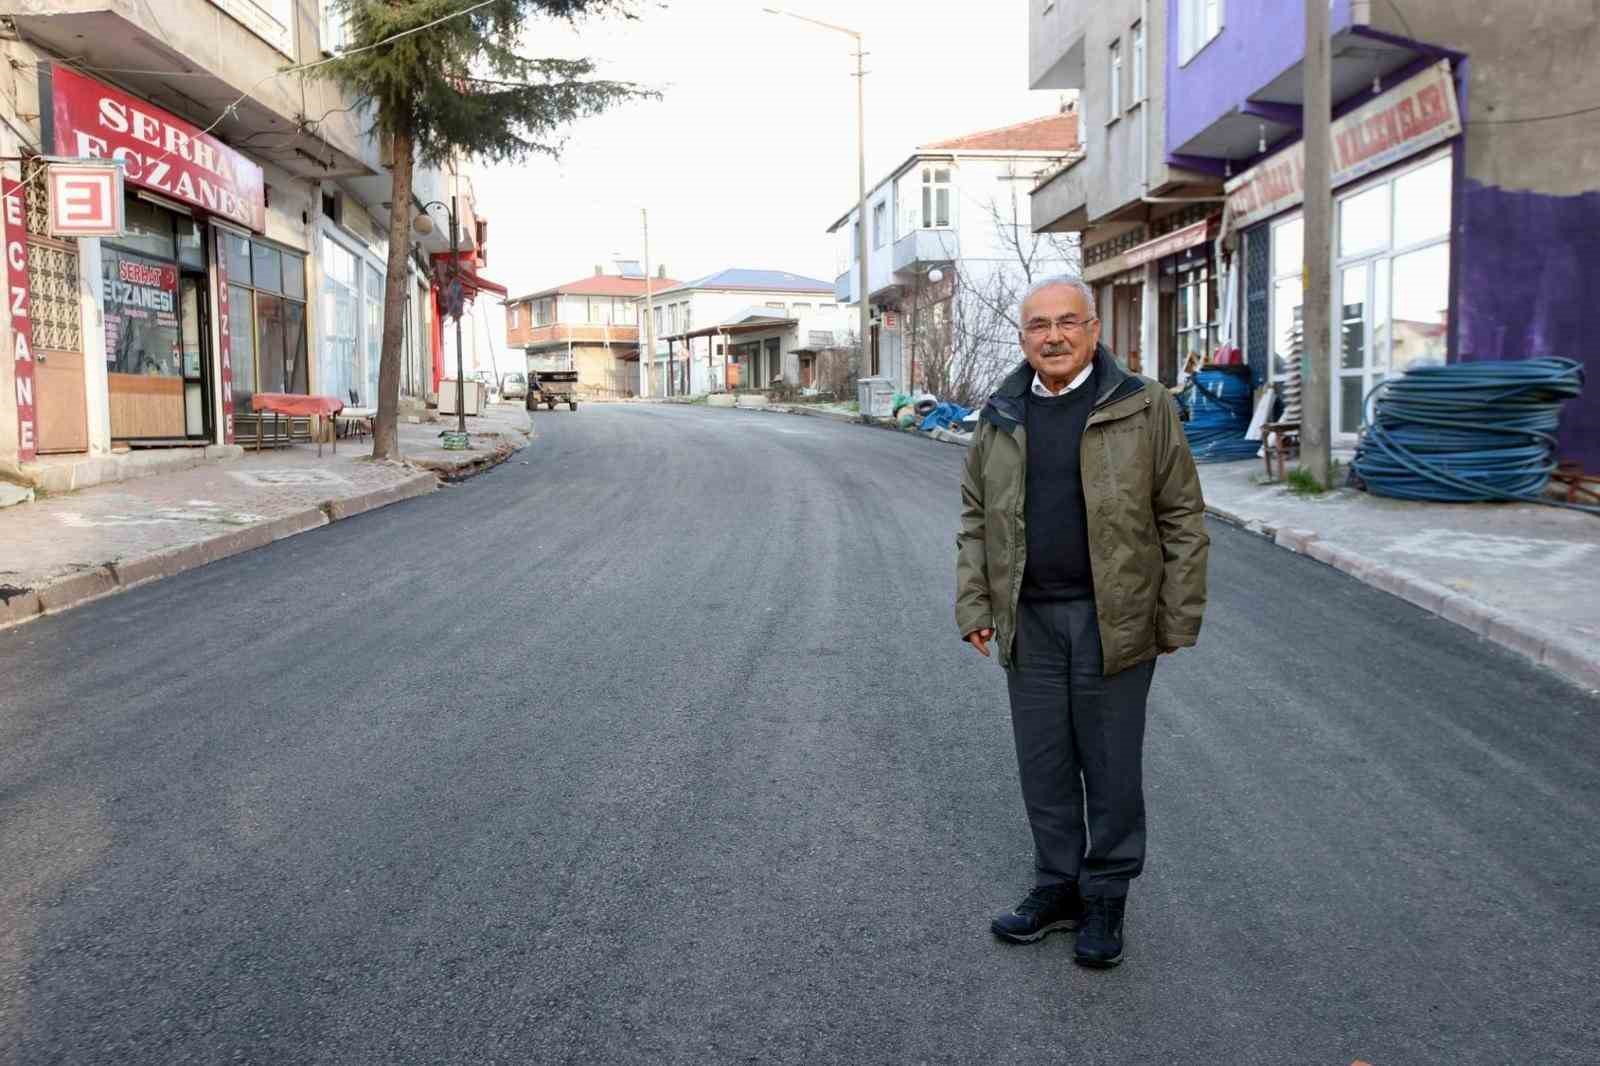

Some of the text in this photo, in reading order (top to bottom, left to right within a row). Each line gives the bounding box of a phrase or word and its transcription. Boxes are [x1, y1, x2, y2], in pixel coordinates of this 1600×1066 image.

[98, 97, 243, 186] SERHA
[119, 260, 161, 287] SERHAT
[6, 196, 34, 449] ECZANE
